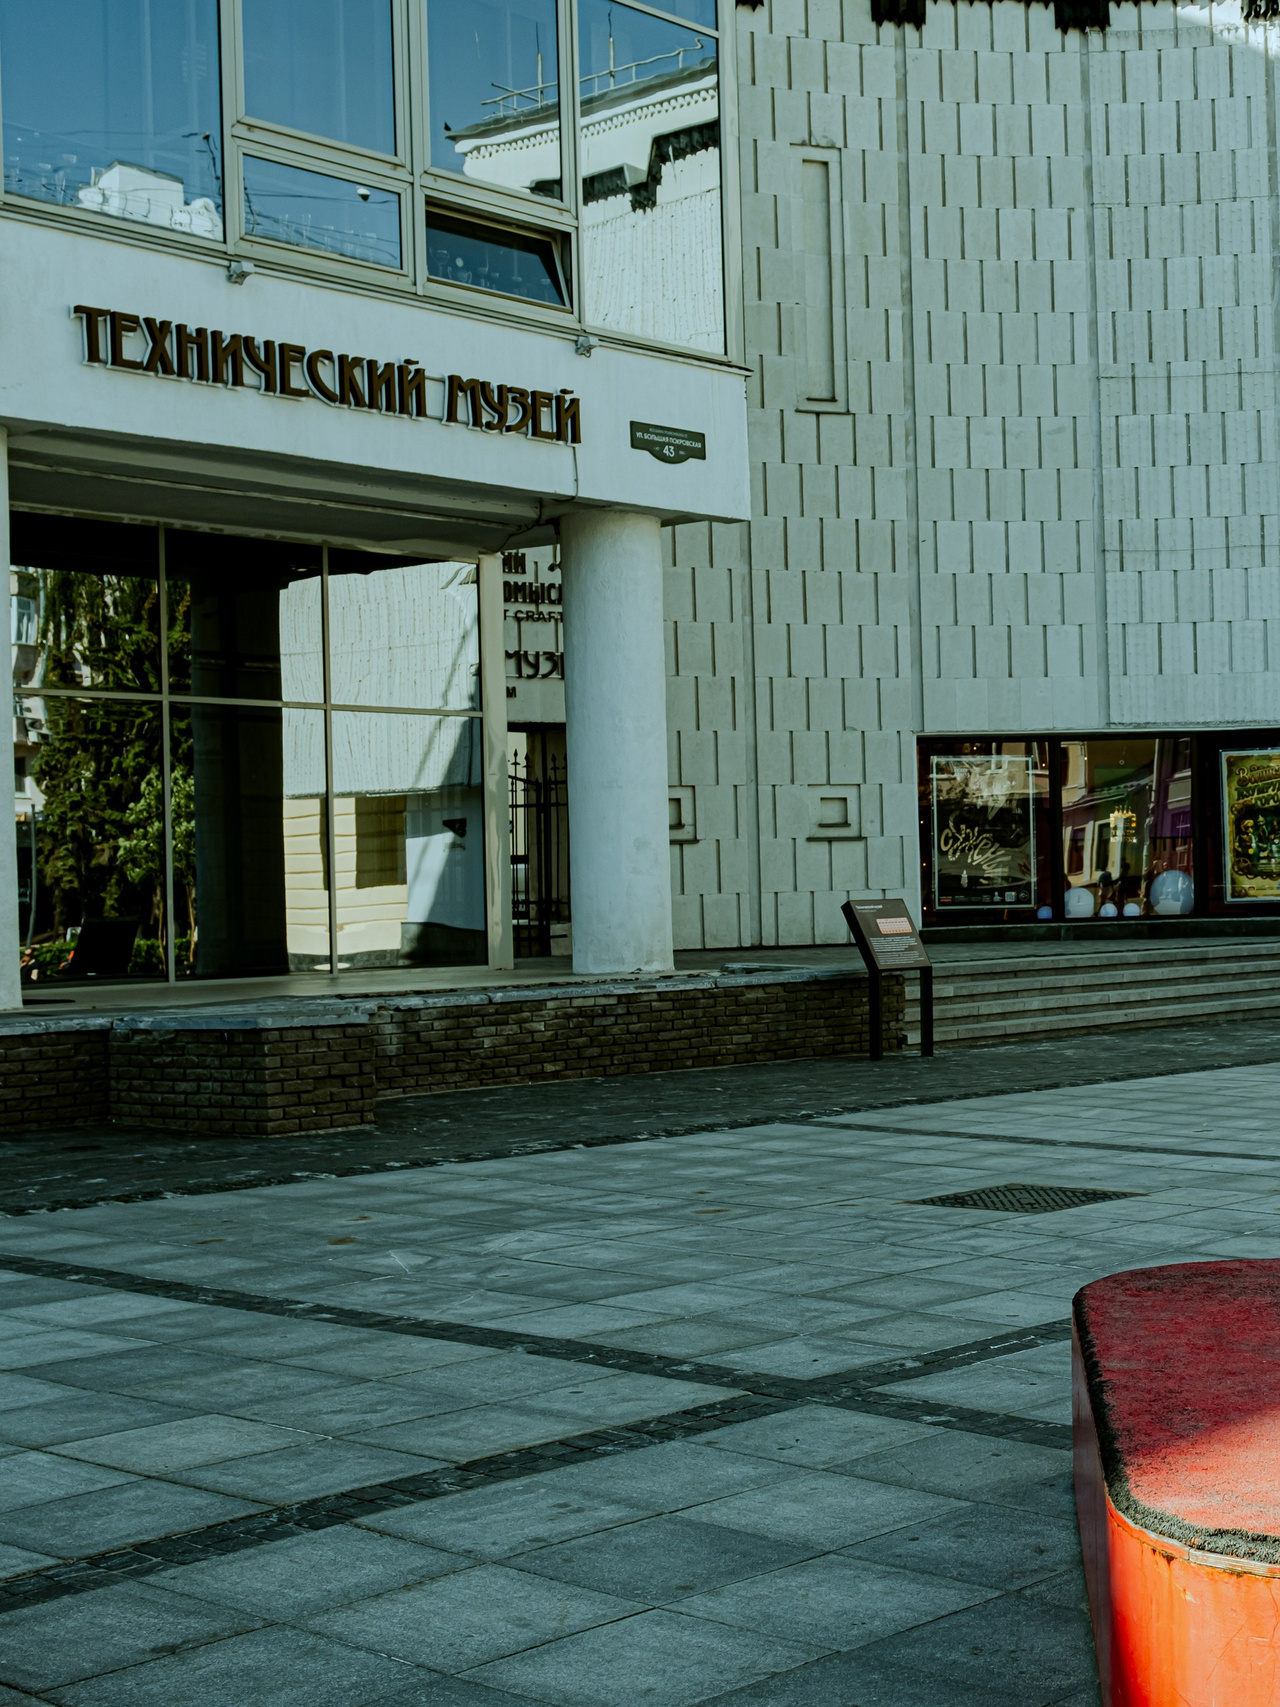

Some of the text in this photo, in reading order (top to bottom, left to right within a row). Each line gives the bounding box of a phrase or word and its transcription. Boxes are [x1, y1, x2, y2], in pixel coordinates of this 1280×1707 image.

[73, 304, 582, 444] ТЕХНИЧЕСКИЙ МУЗЕЙ
[644, 433, 669, 443] БОЛЬШАЯ
[669, 437, 702, 448] ПОКРОВСКАЯ
[663, 445, 675, 457] 43
